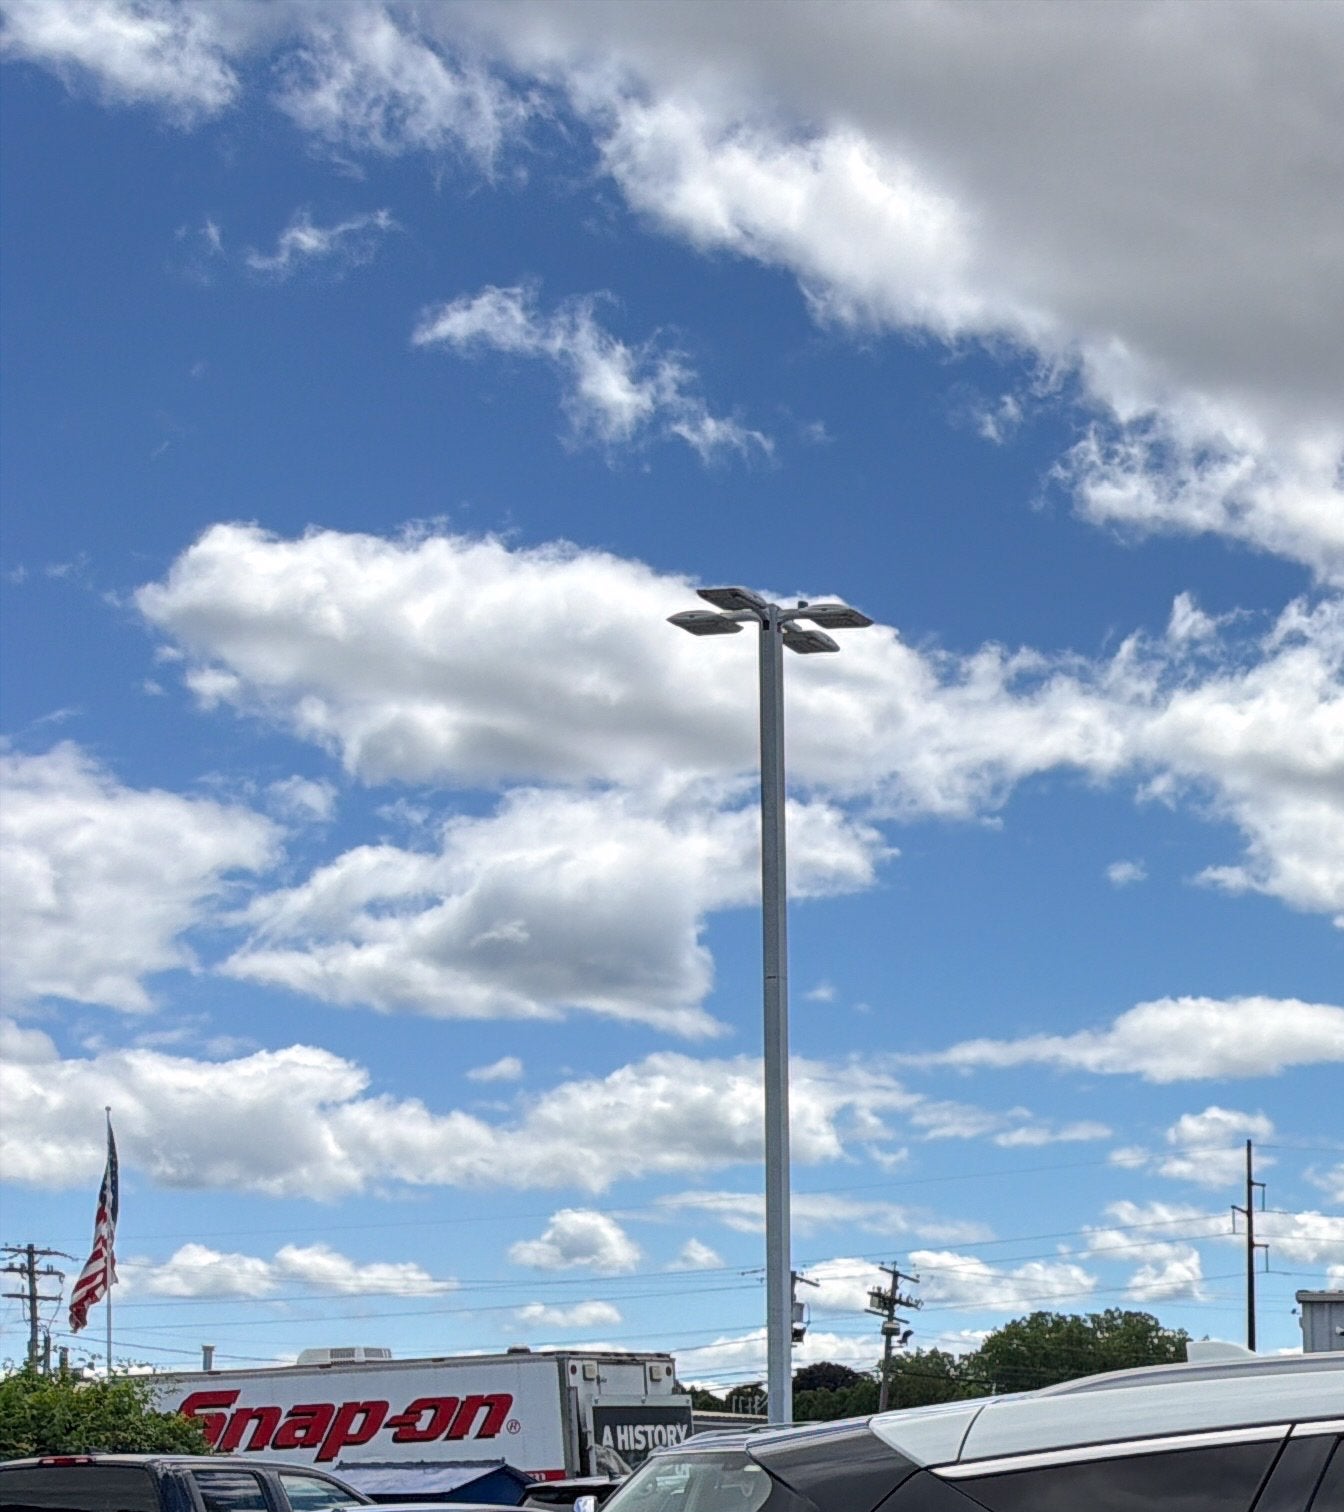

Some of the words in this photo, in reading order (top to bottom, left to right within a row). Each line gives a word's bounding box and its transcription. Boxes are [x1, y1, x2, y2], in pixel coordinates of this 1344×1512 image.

[178, 1389, 513, 1463] Snap-on
[602, 1424, 614, 1448] A
[617, 1423, 688, 1450] HISTORY
